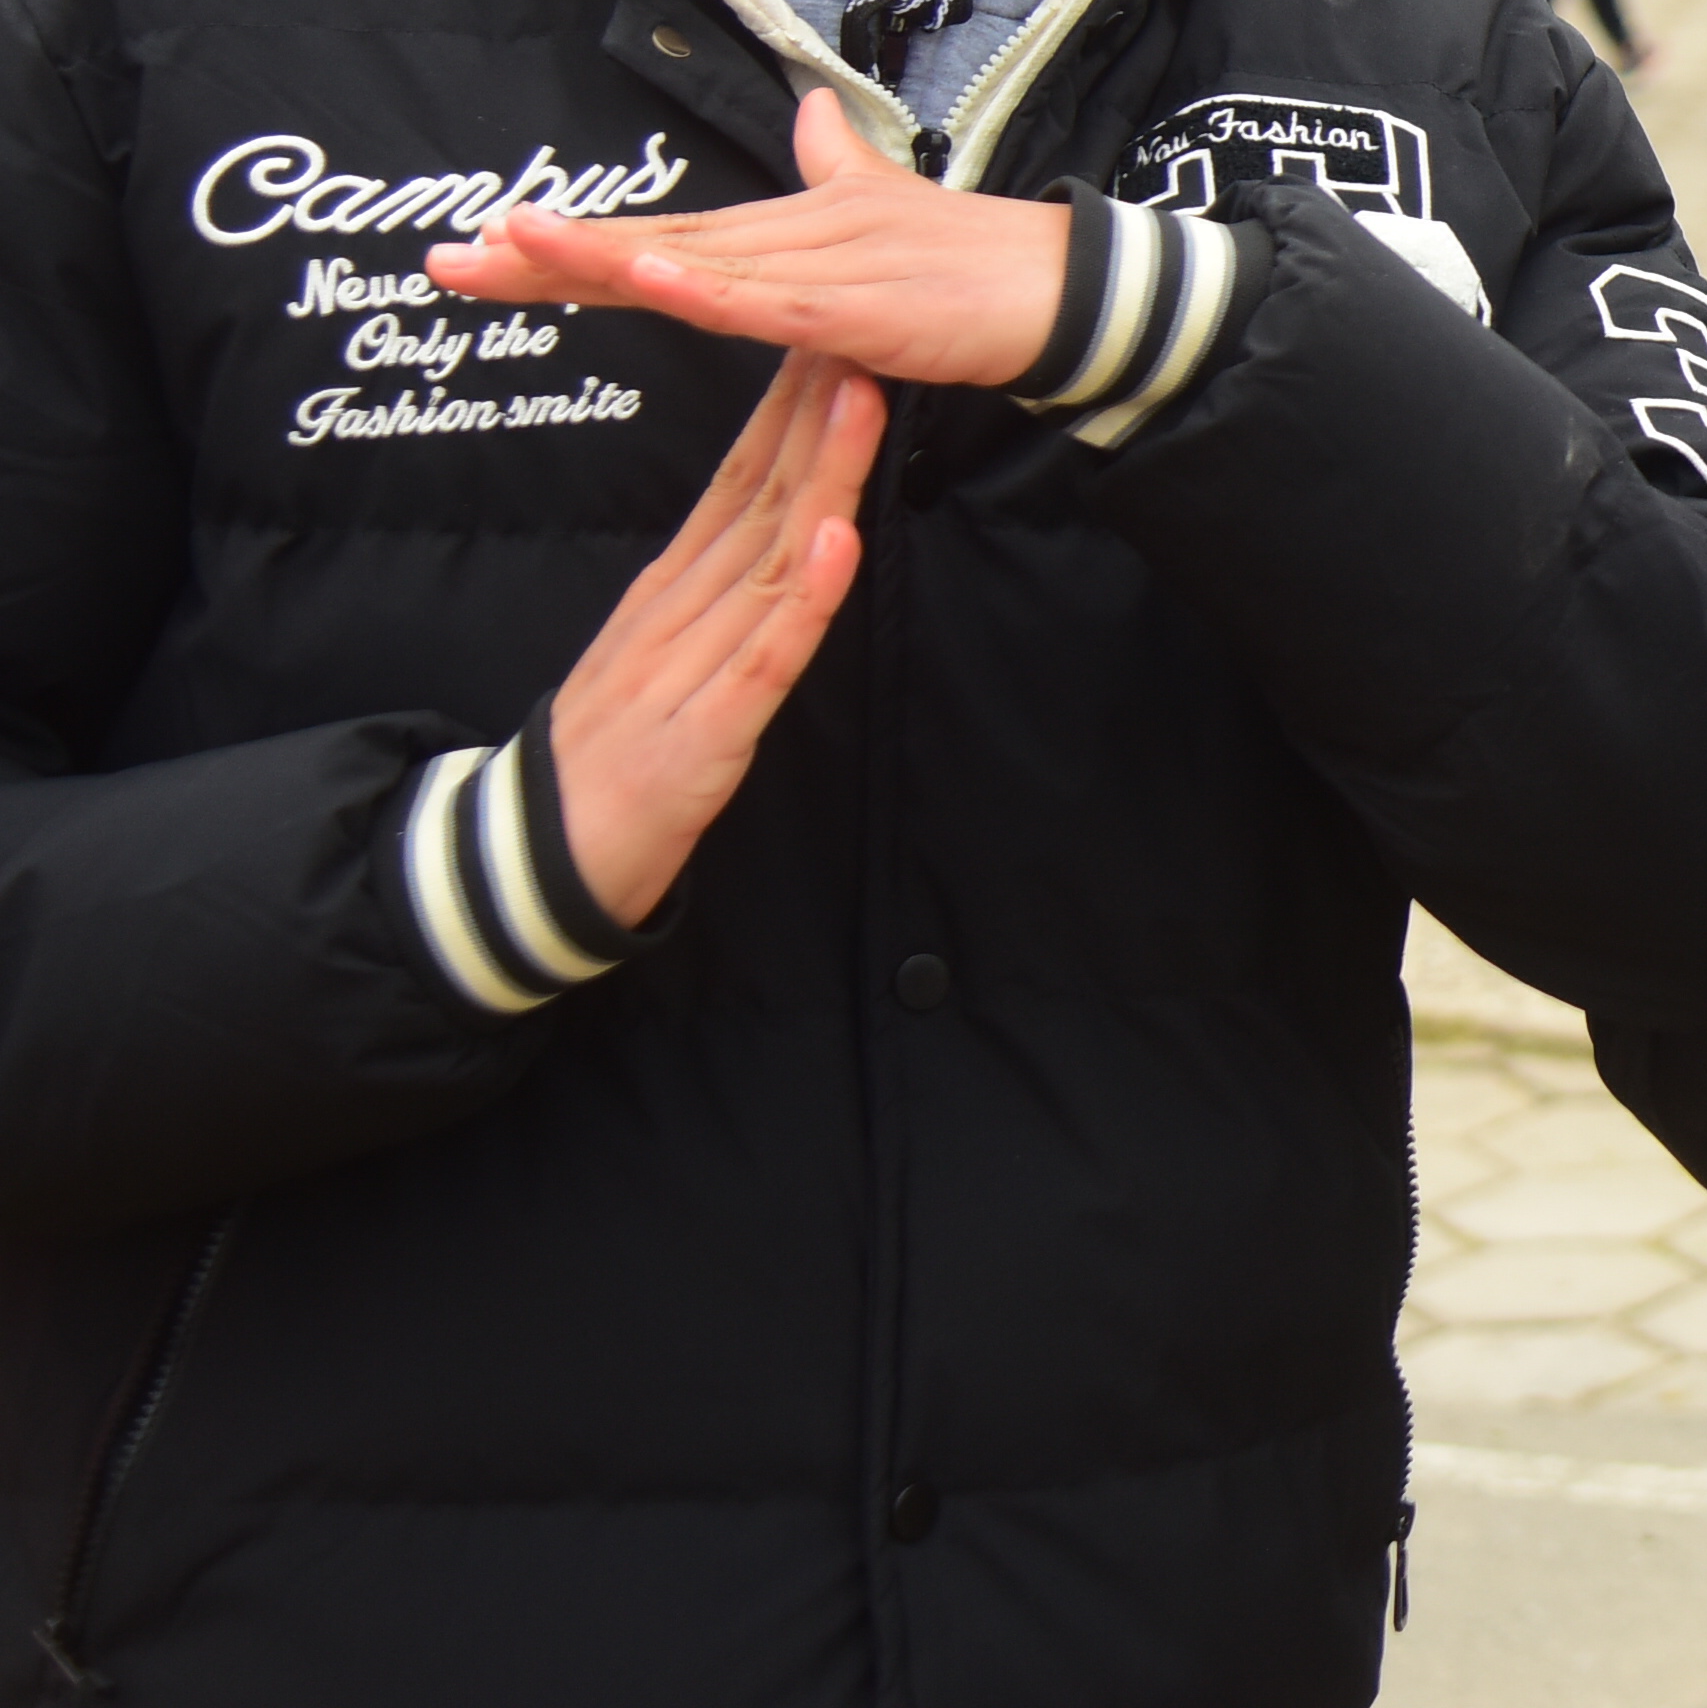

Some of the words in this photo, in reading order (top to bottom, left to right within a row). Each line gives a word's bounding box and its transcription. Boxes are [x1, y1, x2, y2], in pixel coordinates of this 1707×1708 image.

[1204, 105, 1379, 152] Fashion
[192, 132, 690, 246] Campus
[286, 257, 456, 318] Neve
[345, 312, 472, 381] Only
[476, 311, 560, 362] the
